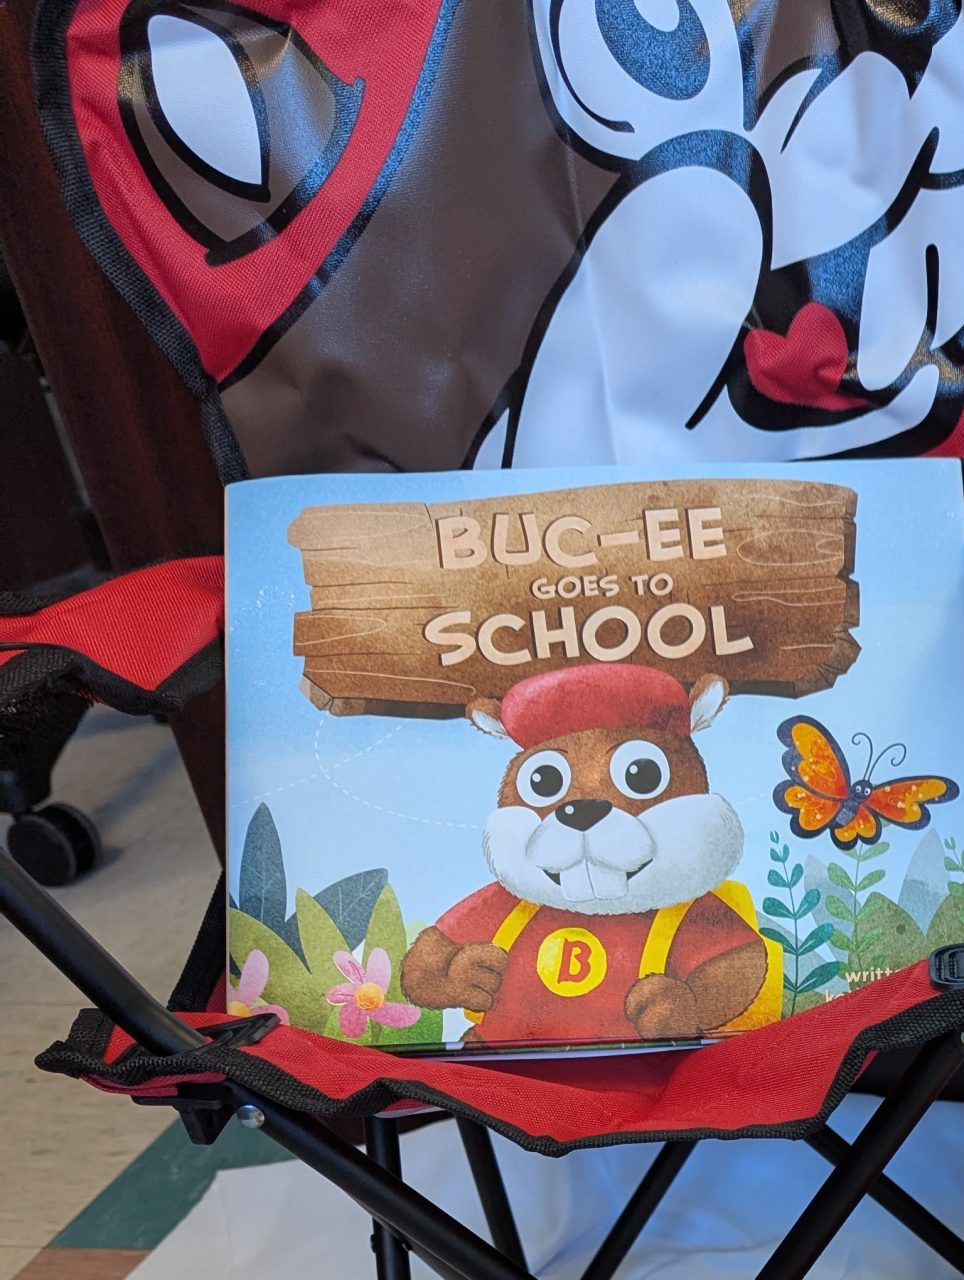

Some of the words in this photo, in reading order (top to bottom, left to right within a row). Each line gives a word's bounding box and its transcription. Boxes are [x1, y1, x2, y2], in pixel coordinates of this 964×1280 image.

[434, 507, 728, 570] BUC-EE
[531, 575, 620, 600] GOES
[629, 572, 674, 597] TO
[423, 602, 755, 667] SCHOOL
[557, 937, 592, 985] B
[845, 967, 900, 982] writt
